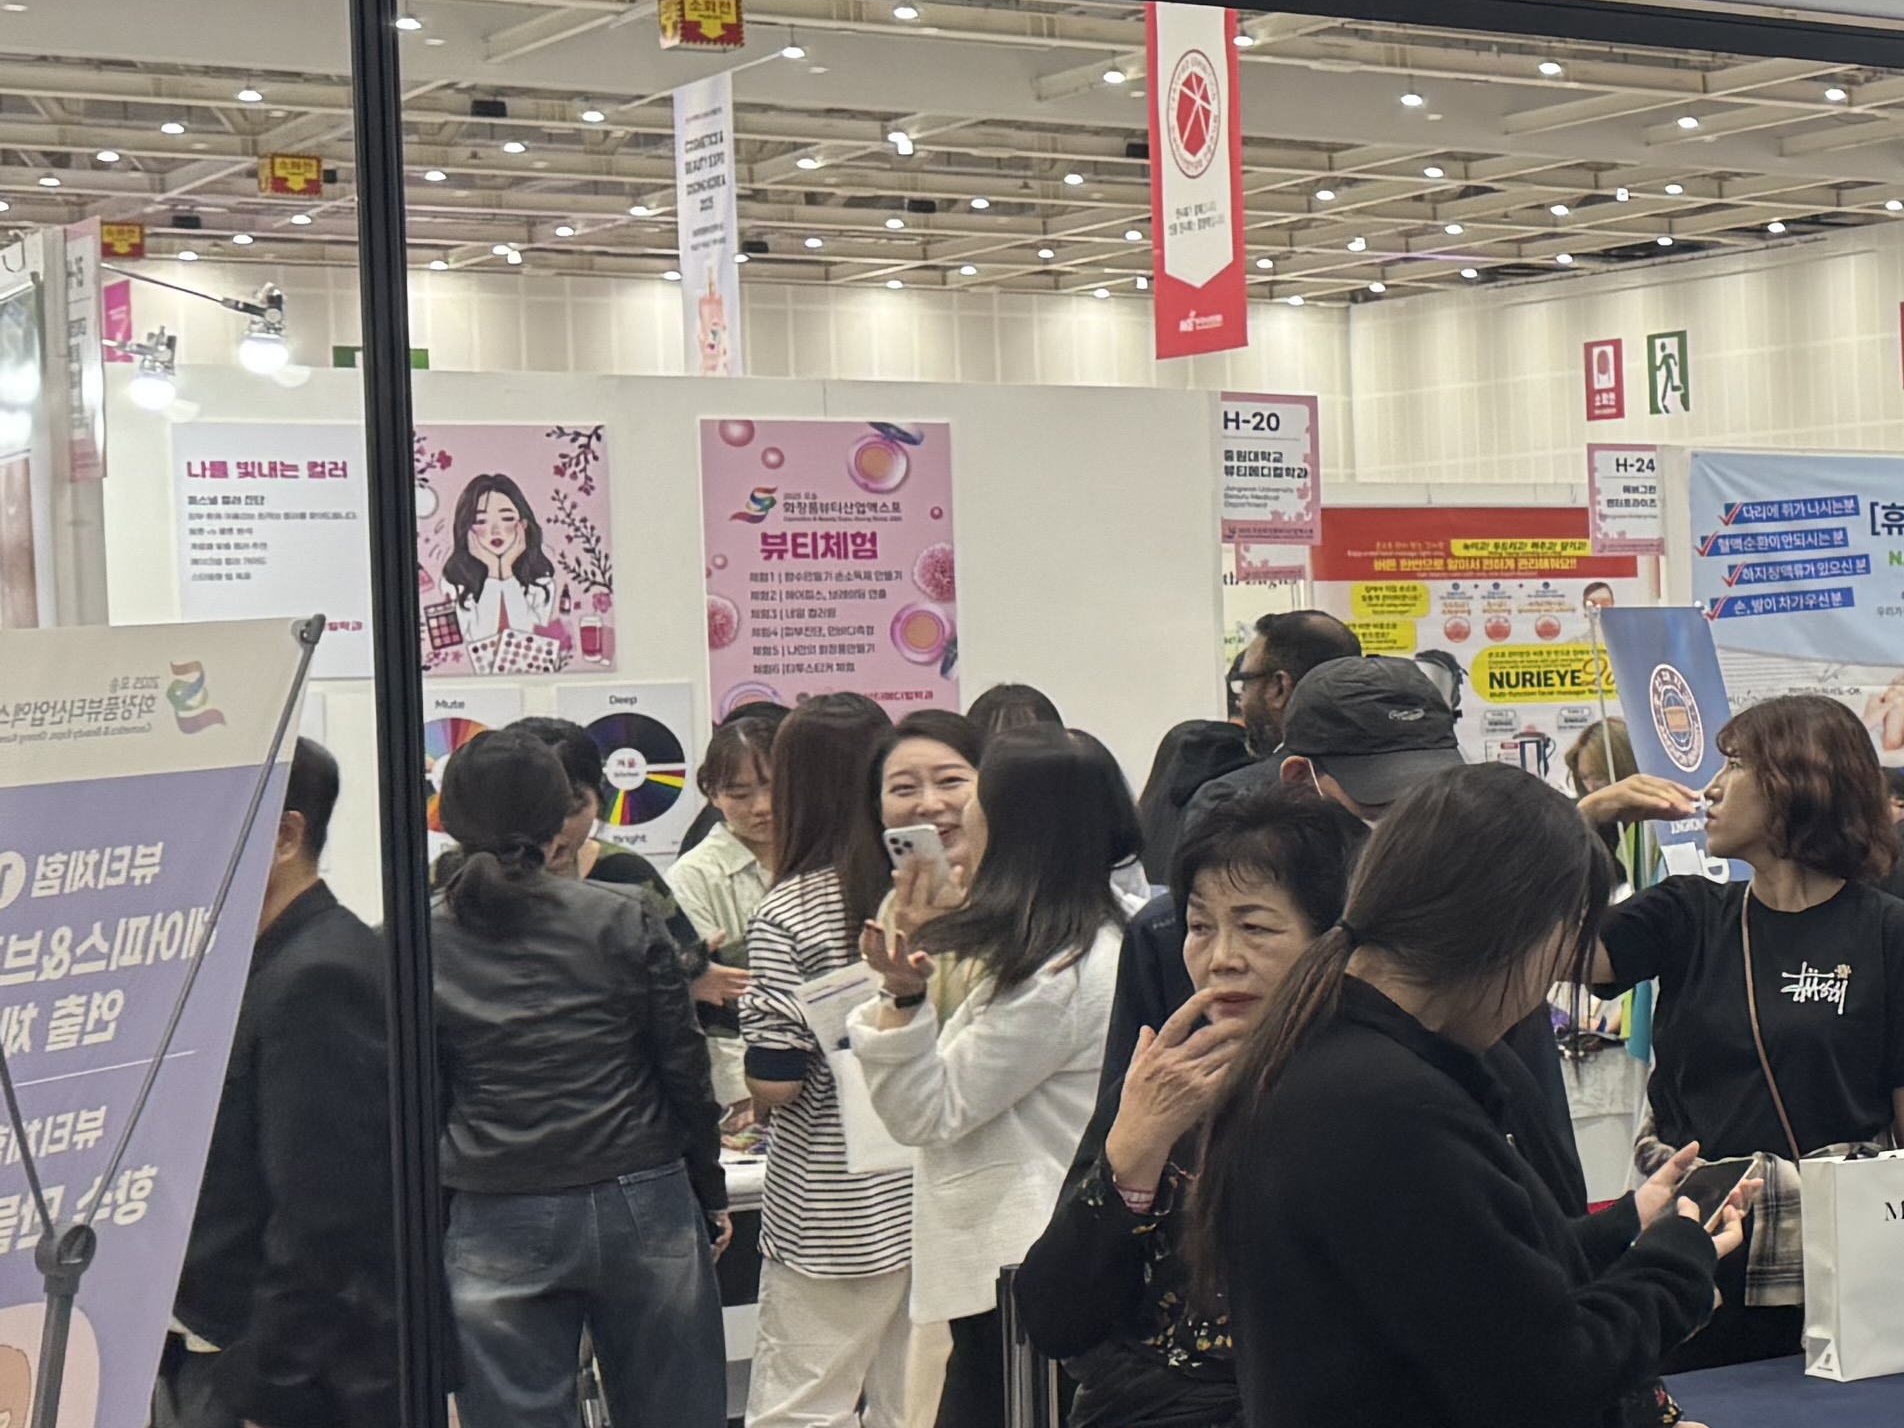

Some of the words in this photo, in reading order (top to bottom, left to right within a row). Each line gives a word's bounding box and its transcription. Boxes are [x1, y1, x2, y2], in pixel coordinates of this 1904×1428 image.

[1223, 411, 1280, 432] H-20
[186, 460, 229, 479] 나를
[236, 460, 300, 479] 빛내는
[307, 460, 348, 479] 컬러
[1224, 465, 1308, 479] 뷰티메디컬학과
[1616, 457, 1655, 473] H-24
[784, 502, 902, 515] 화장품뷰티산업엑스포
[1742, 504, 1779, 520] 다리에
[760, 531, 878, 560] 뷰티체험
[1489, 669, 1583, 690] NURIEYE
[609, 695, 637, 707] Deep
